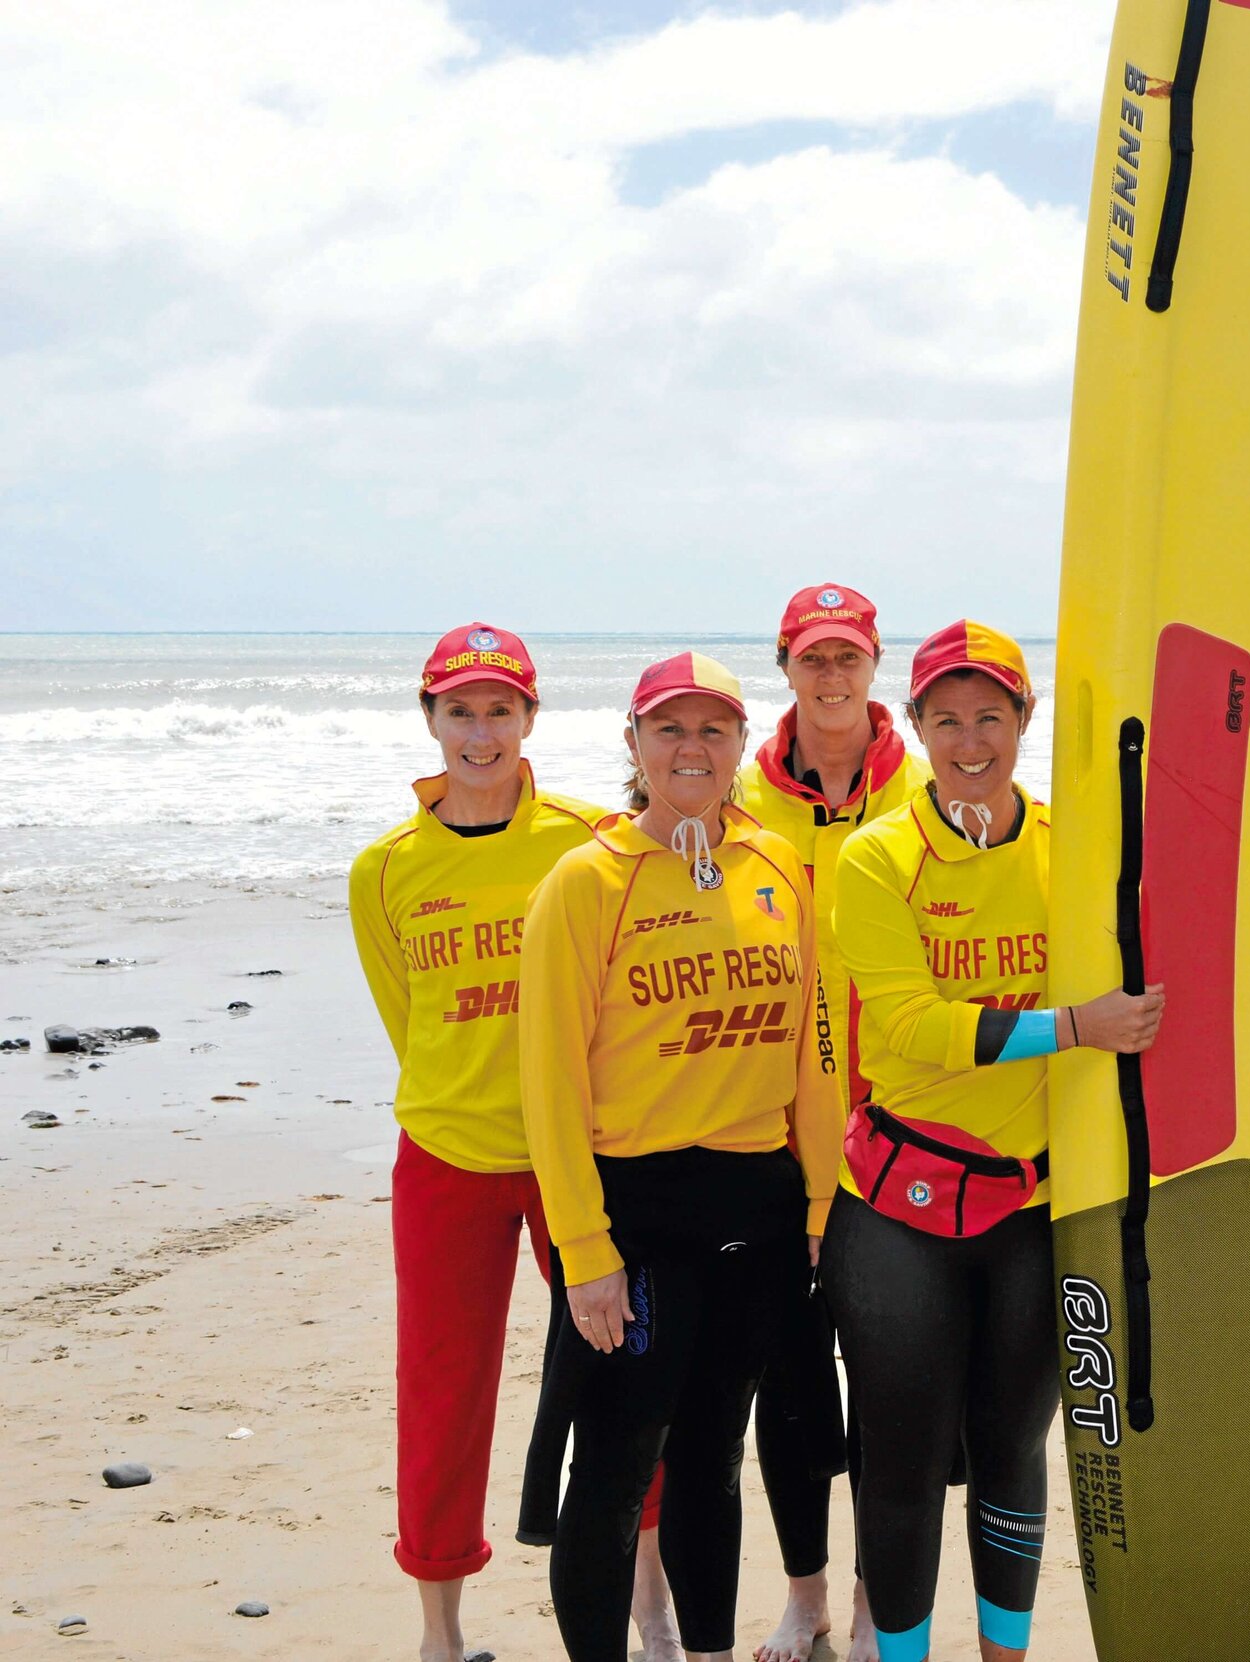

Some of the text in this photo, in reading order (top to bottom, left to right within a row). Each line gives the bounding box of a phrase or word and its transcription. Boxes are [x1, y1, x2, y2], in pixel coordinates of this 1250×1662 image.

[1107, 61, 1146, 303] BENNETT
[798, 609, 863, 624] MARINE RESCUE
[445, 651, 523, 676] SURF RESCUE
[418, 897, 456, 916] DHL
[633, 911, 700, 933] DHL
[928, 901, 964, 917] DHL
[474, 916, 525, 960] RES
[996, 932, 1048, 977] RES
[628, 943, 803, 1007] SURF RESCU
[683, 1001, 789, 1054] DHL
[1063, 1275, 1120, 1446] BRT
[1088, 1452, 1108, 1537] RESCUE
[1104, 1453, 1128, 1553] BENNETT
[1075, 1451, 1099, 1595] TECHNOLOGY
